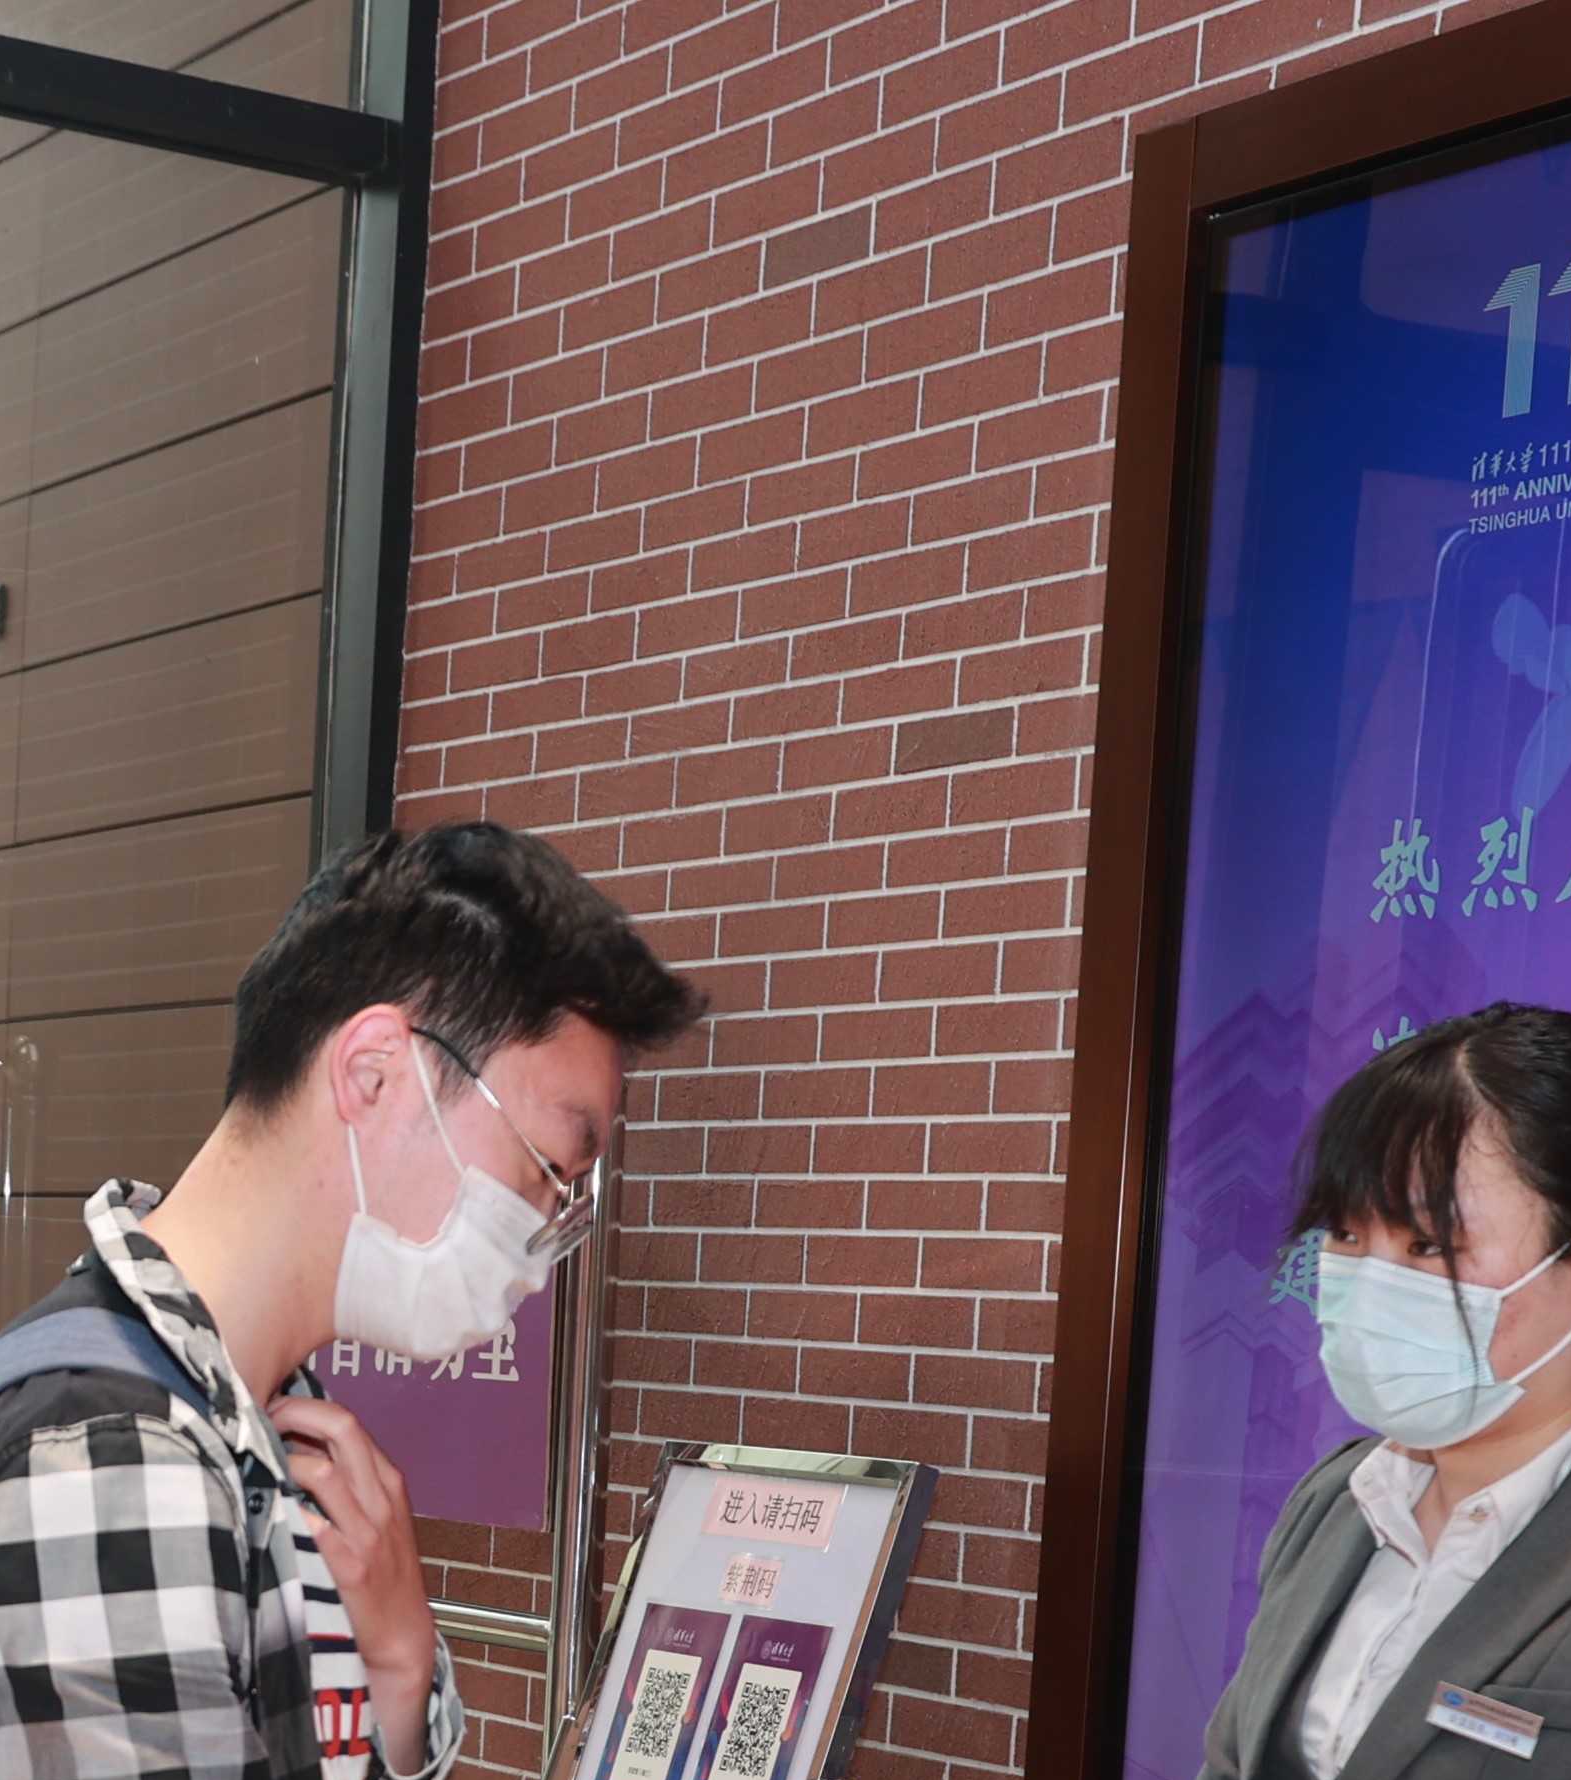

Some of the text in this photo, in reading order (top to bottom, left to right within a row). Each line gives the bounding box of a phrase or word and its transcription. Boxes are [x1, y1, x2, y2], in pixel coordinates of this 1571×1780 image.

[1470, 483, 1510, 509] 111th
[1469, 503, 1551, 535] TSINGHUA
[720, 1490, 824, 1534] 进入请扫码
